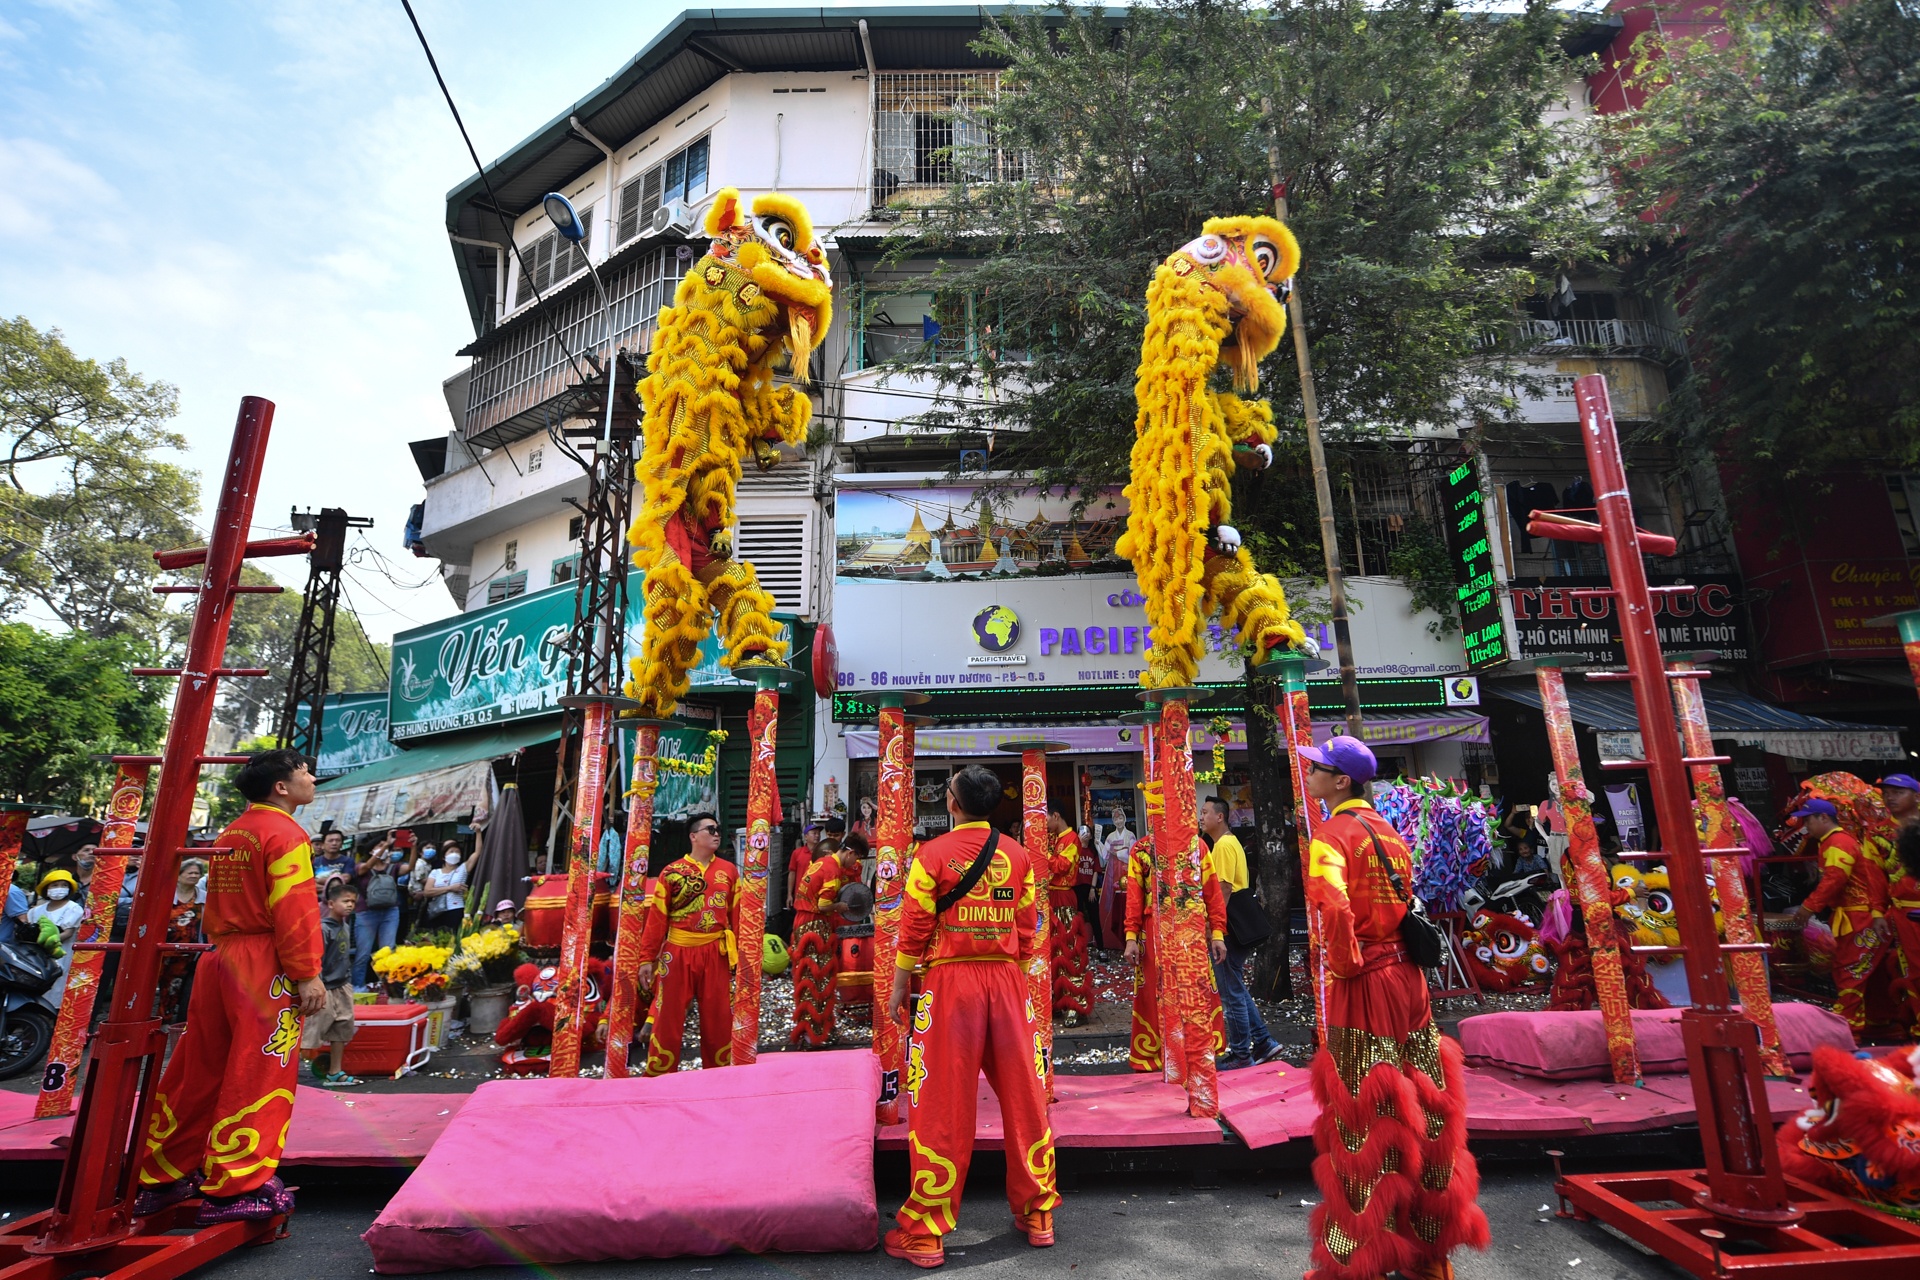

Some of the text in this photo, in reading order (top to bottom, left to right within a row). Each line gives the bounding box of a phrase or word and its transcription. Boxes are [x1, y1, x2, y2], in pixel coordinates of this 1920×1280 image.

[1469, 563, 1475, 577] E
[1831, 562, 1902, 588] Chuyên
[1107, 588, 1147, 607] CÔN
[1464, 590, 1491, 614] 7tr990
[1040, 625, 1153, 657] PACIFI
[1465, 622, 1501, 649] DAI LOAN
[1549, 626, 1572, 645] CHÍ
[1574, 628, 1609, 645] MINH
[1670, 624, 1691, 643] MÊ
[1694, 622, 1737, 646] THUỘT
[438, 618, 526, 699] Yến
[970, 655, 1025, 663] PACIFICTRAVEL
[1601, 651, 1613, 662] Q.5
[838, 672, 854, 687] 98
[871, 671, 888, 686] 96
[892, 671, 931, 686] NGUYỄN
[935, 674, 955, 684] DUY
[1028, 671, 1045, 682] Q.5
[1078, 670, 1119, 681] HOTLINE
[393, 725, 406, 738] 265
[478, 709, 493, 723] Q.5
[1362, 725, 1417, 740] ACIFIC
[996, 890, 1012, 898] TAC
[958, 906, 1015, 923] DIMSUM
[768, 939, 781, 954] 8
[43, 1062, 67, 1092] 8
